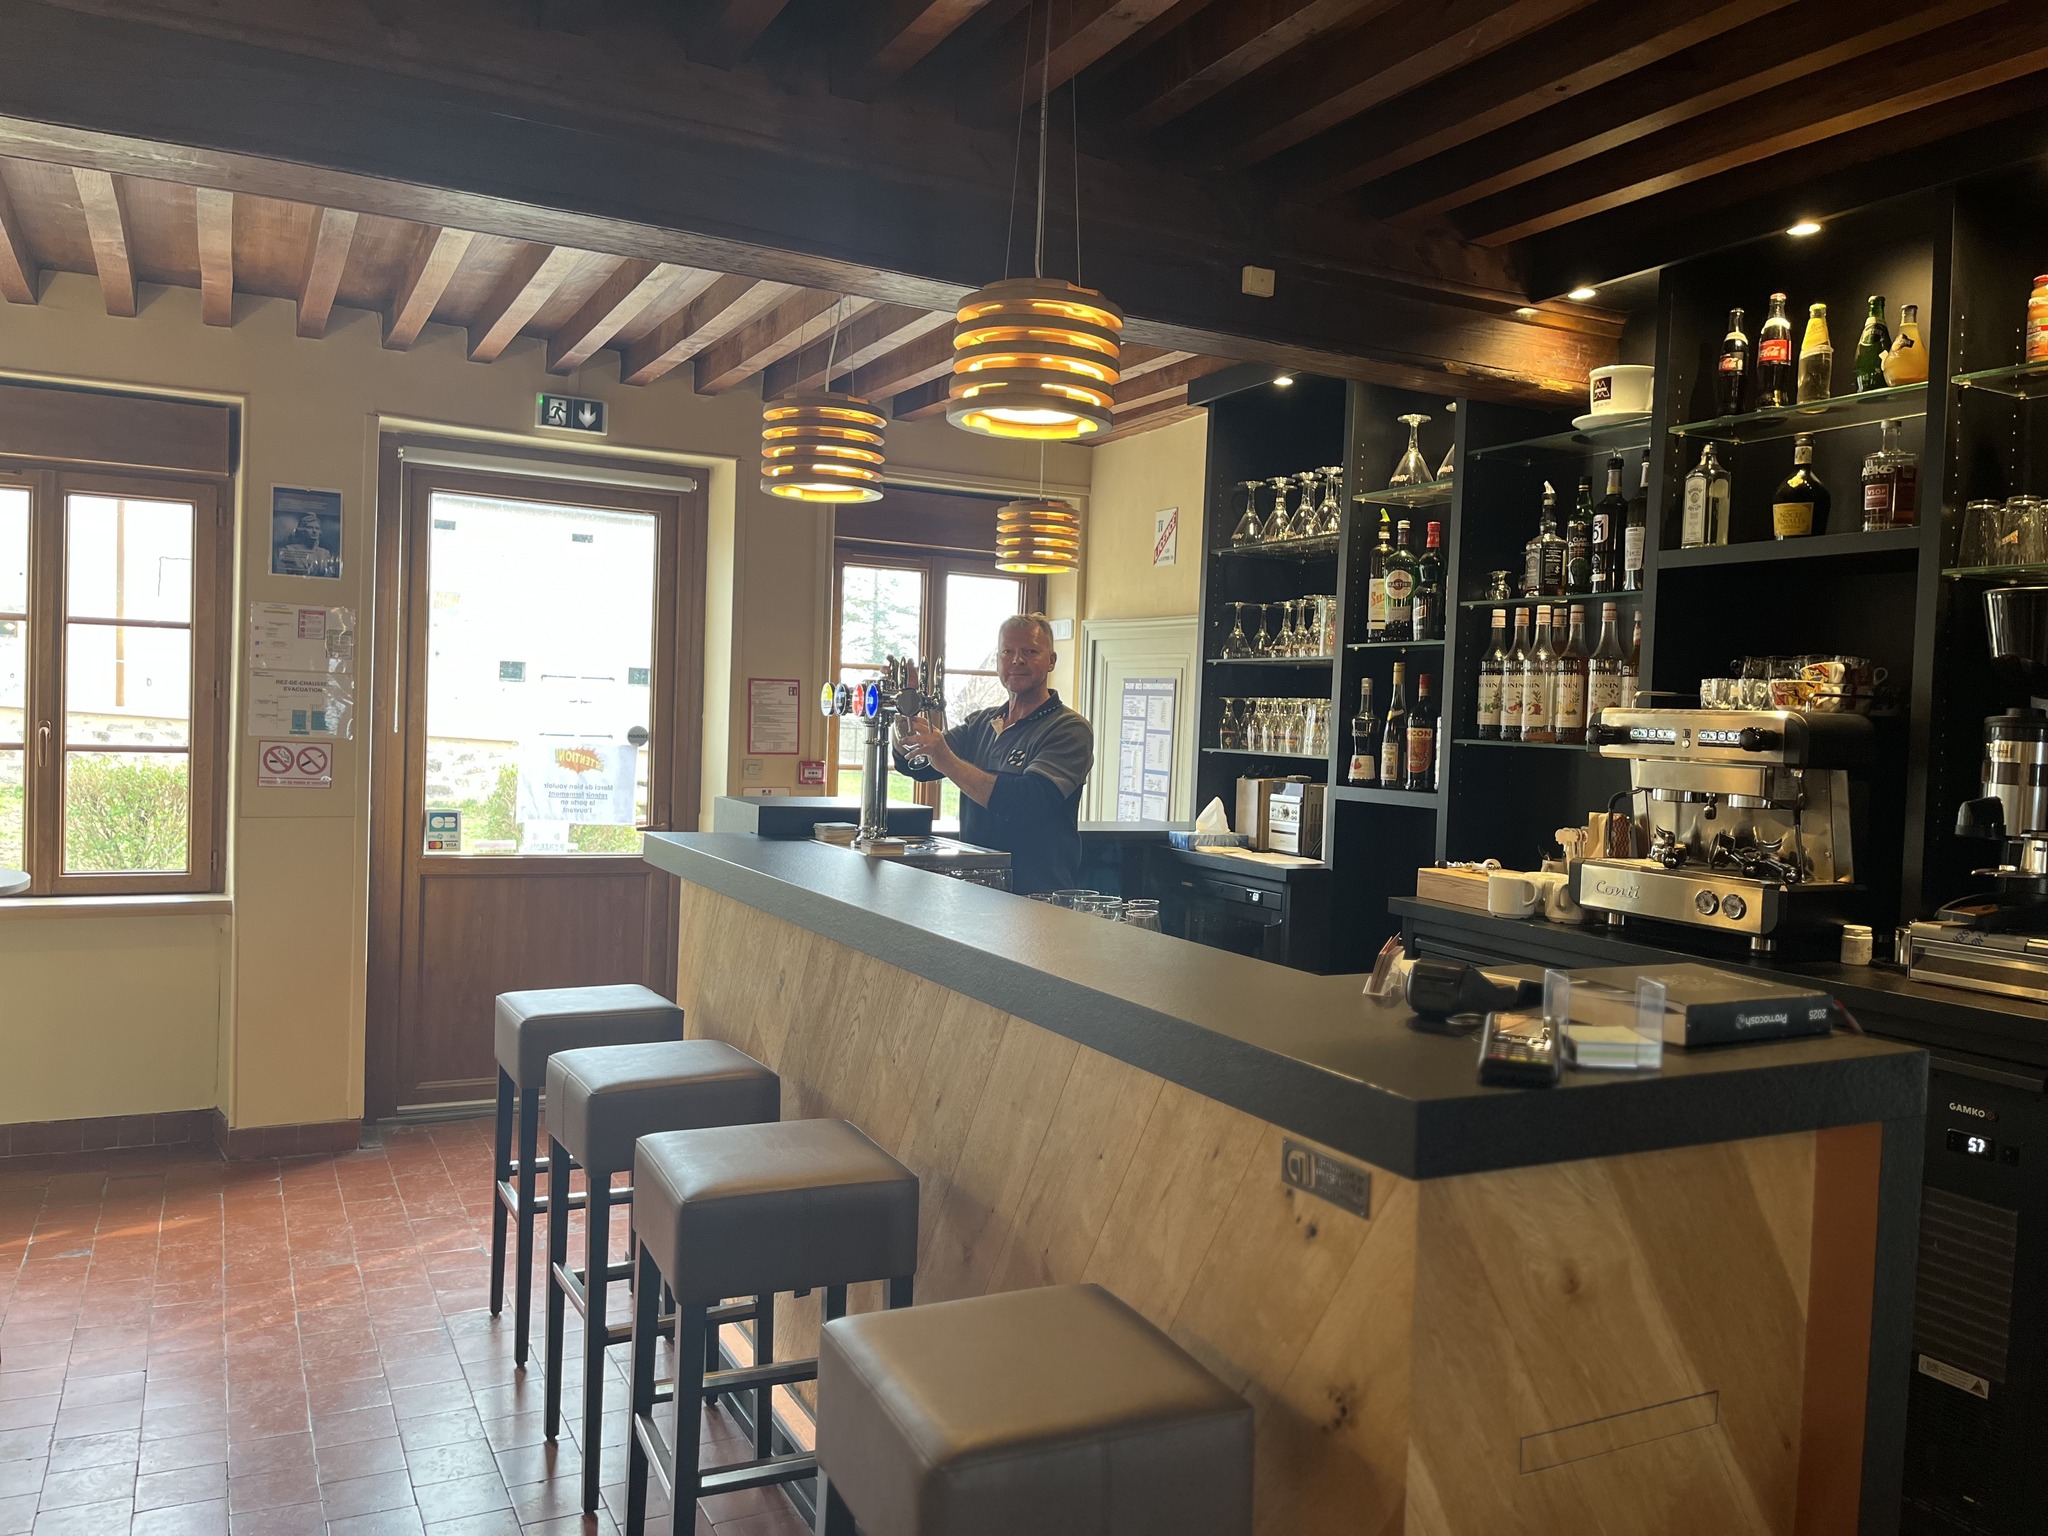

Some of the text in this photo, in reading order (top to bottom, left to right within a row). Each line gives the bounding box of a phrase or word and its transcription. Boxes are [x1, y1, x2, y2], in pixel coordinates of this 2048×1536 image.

[1596, 880, 1640, 899] Conti
[1745, 1013, 1788, 1027] Promocash
[1808, 1008, 1827, 1020] 2025
[1949, 1102, 1986, 1118] GAMKO
